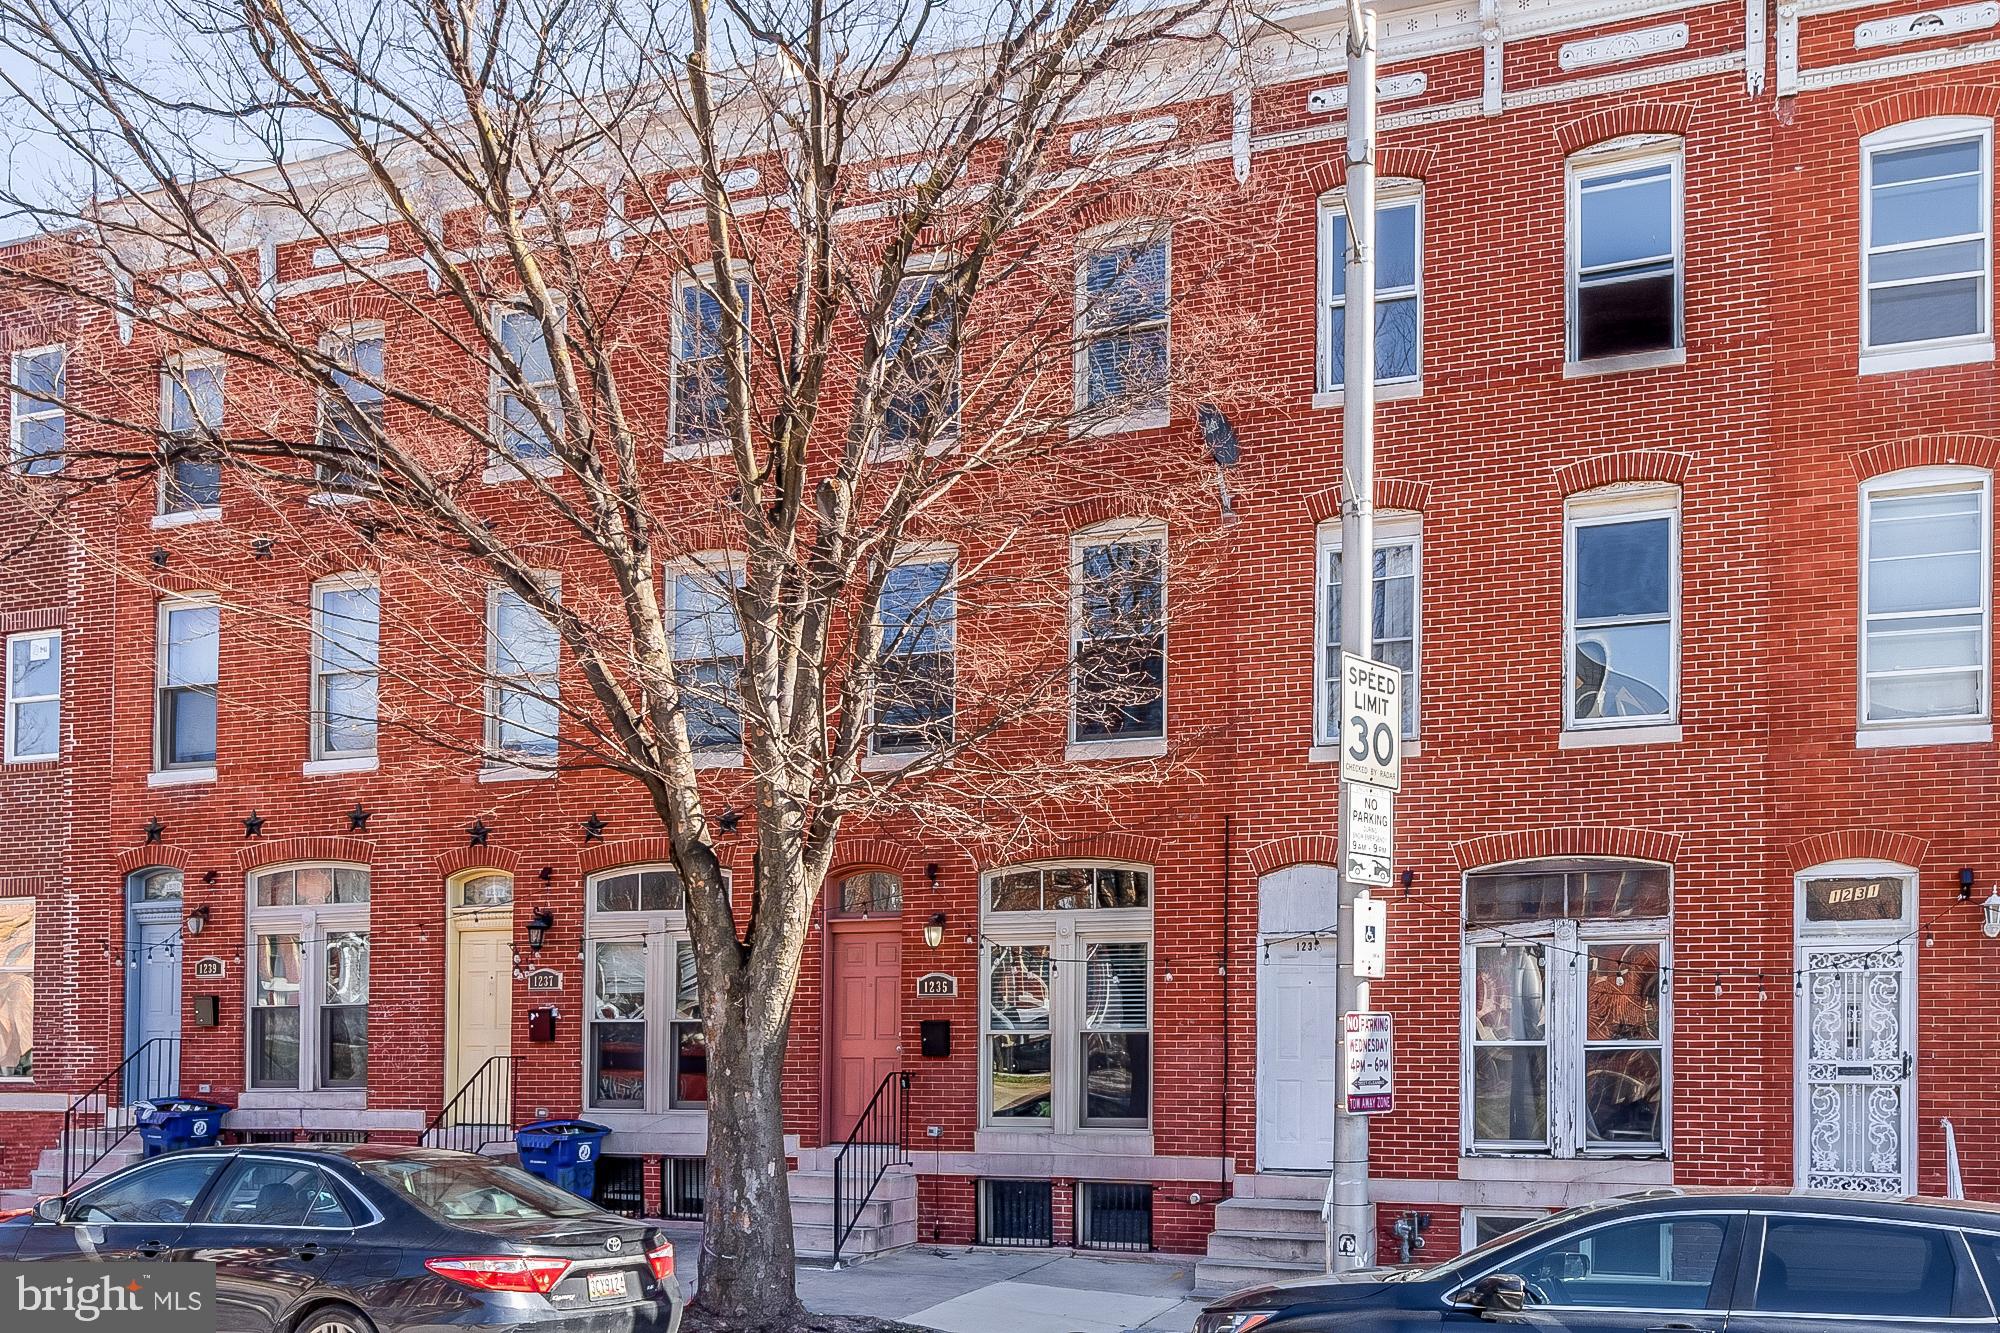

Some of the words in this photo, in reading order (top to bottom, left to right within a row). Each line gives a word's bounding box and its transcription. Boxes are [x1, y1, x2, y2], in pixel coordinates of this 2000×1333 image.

[1349, 667, 1396, 695] SPEED
[1355, 691, 1389, 716] LIMIT
[1349, 715, 1394, 767] 30
[1345, 763, 1369, 775] CHECKED
[1370, 768, 1378, 776] BY
[1379, 770, 1396, 781] RADAR
[1364, 797, 1378, 811] NO
[1353, 810, 1388, 827] PARKING
[1830, 885, 1880, 903] 1231
[199, 963, 217, 974] 1239
[534, 975, 554, 987] 1237
[925, 981, 947, 992] 1235
[1347, 1016, 1359, 1031] NO
[1360, 1018, 1389, 1032] PARKING
[1350, 1038, 1389, 1053] WEDNESDAY
[1350, 1058, 1366, 1073] 4PM
[1374, 1057, 1389, 1072] 6PM
[1350, 1098, 1361, 1110] TOW
[1361, 1097, 1376, 1109] AWAY
[1376, 1096, 1391, 1108] ZONE
